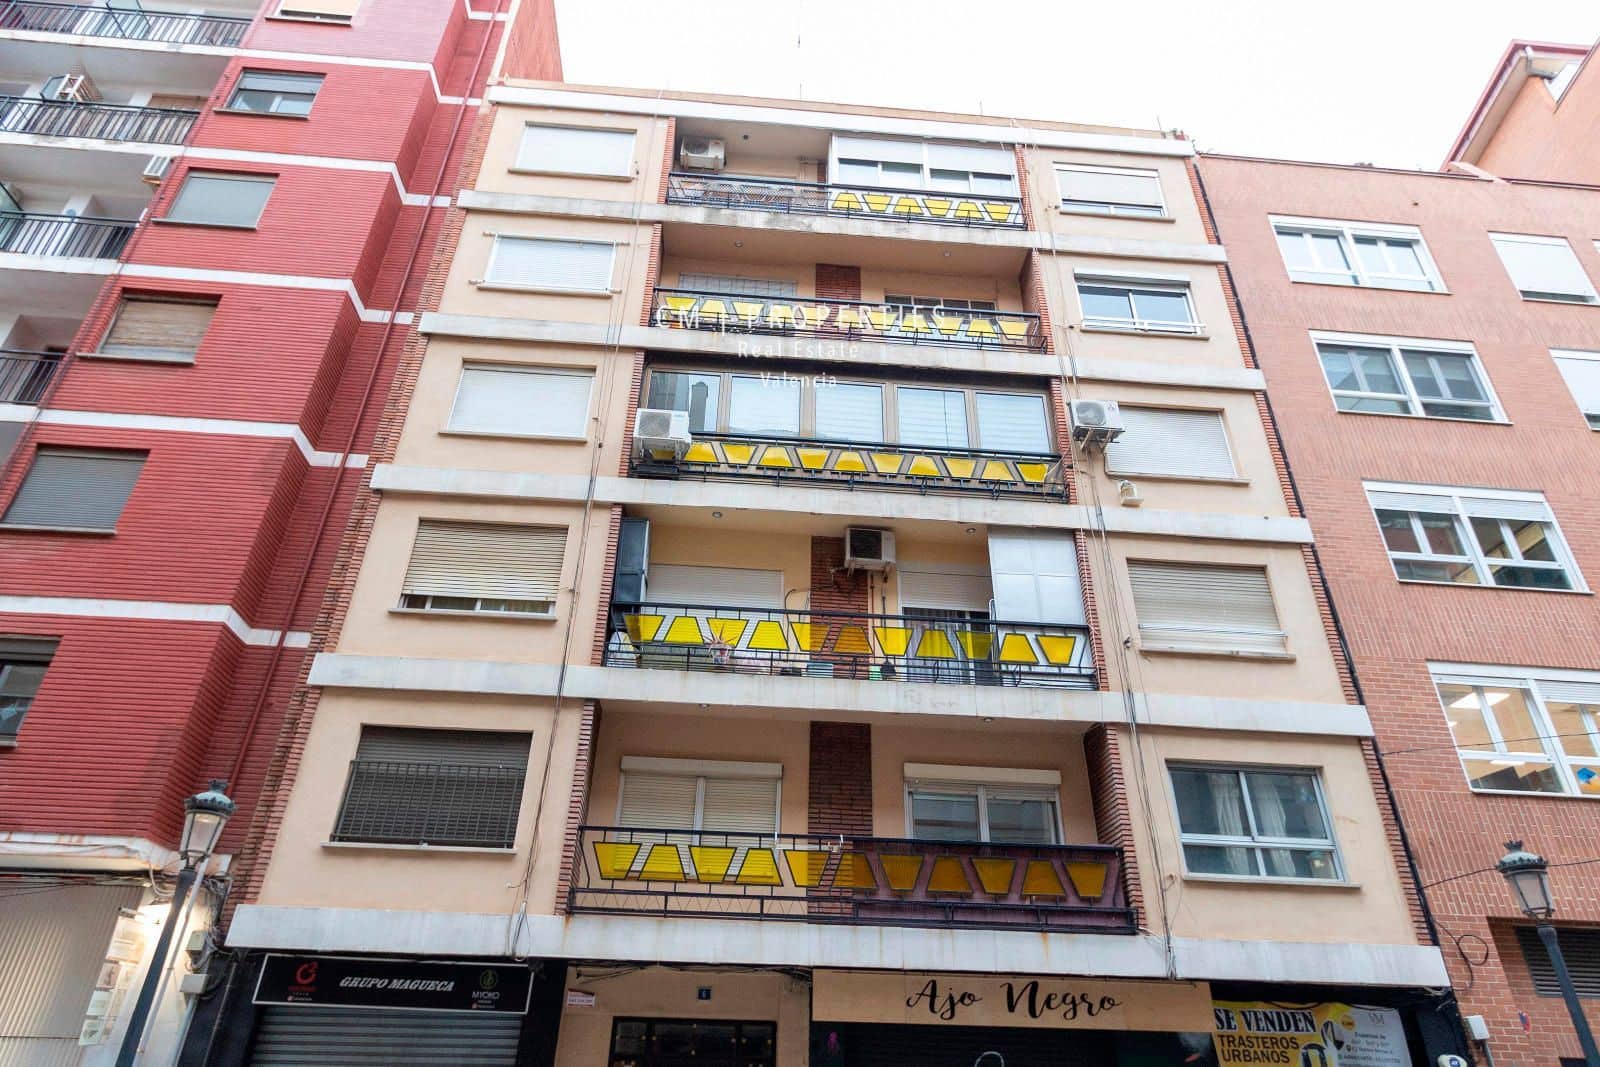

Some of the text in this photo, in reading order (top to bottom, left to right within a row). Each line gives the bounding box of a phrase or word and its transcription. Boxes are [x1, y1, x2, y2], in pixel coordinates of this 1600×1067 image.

[339, 976, 455, 992] GRUPO MAGUECA
[906, 978, 1123, 1021] Ajo Negro
[1213, 1007, 1317, 1033] SE VENDEN
[1217, 1034, 1299, 1051] TRASTEROS
[1220, 1048, 1291, 1064] URBANOS
